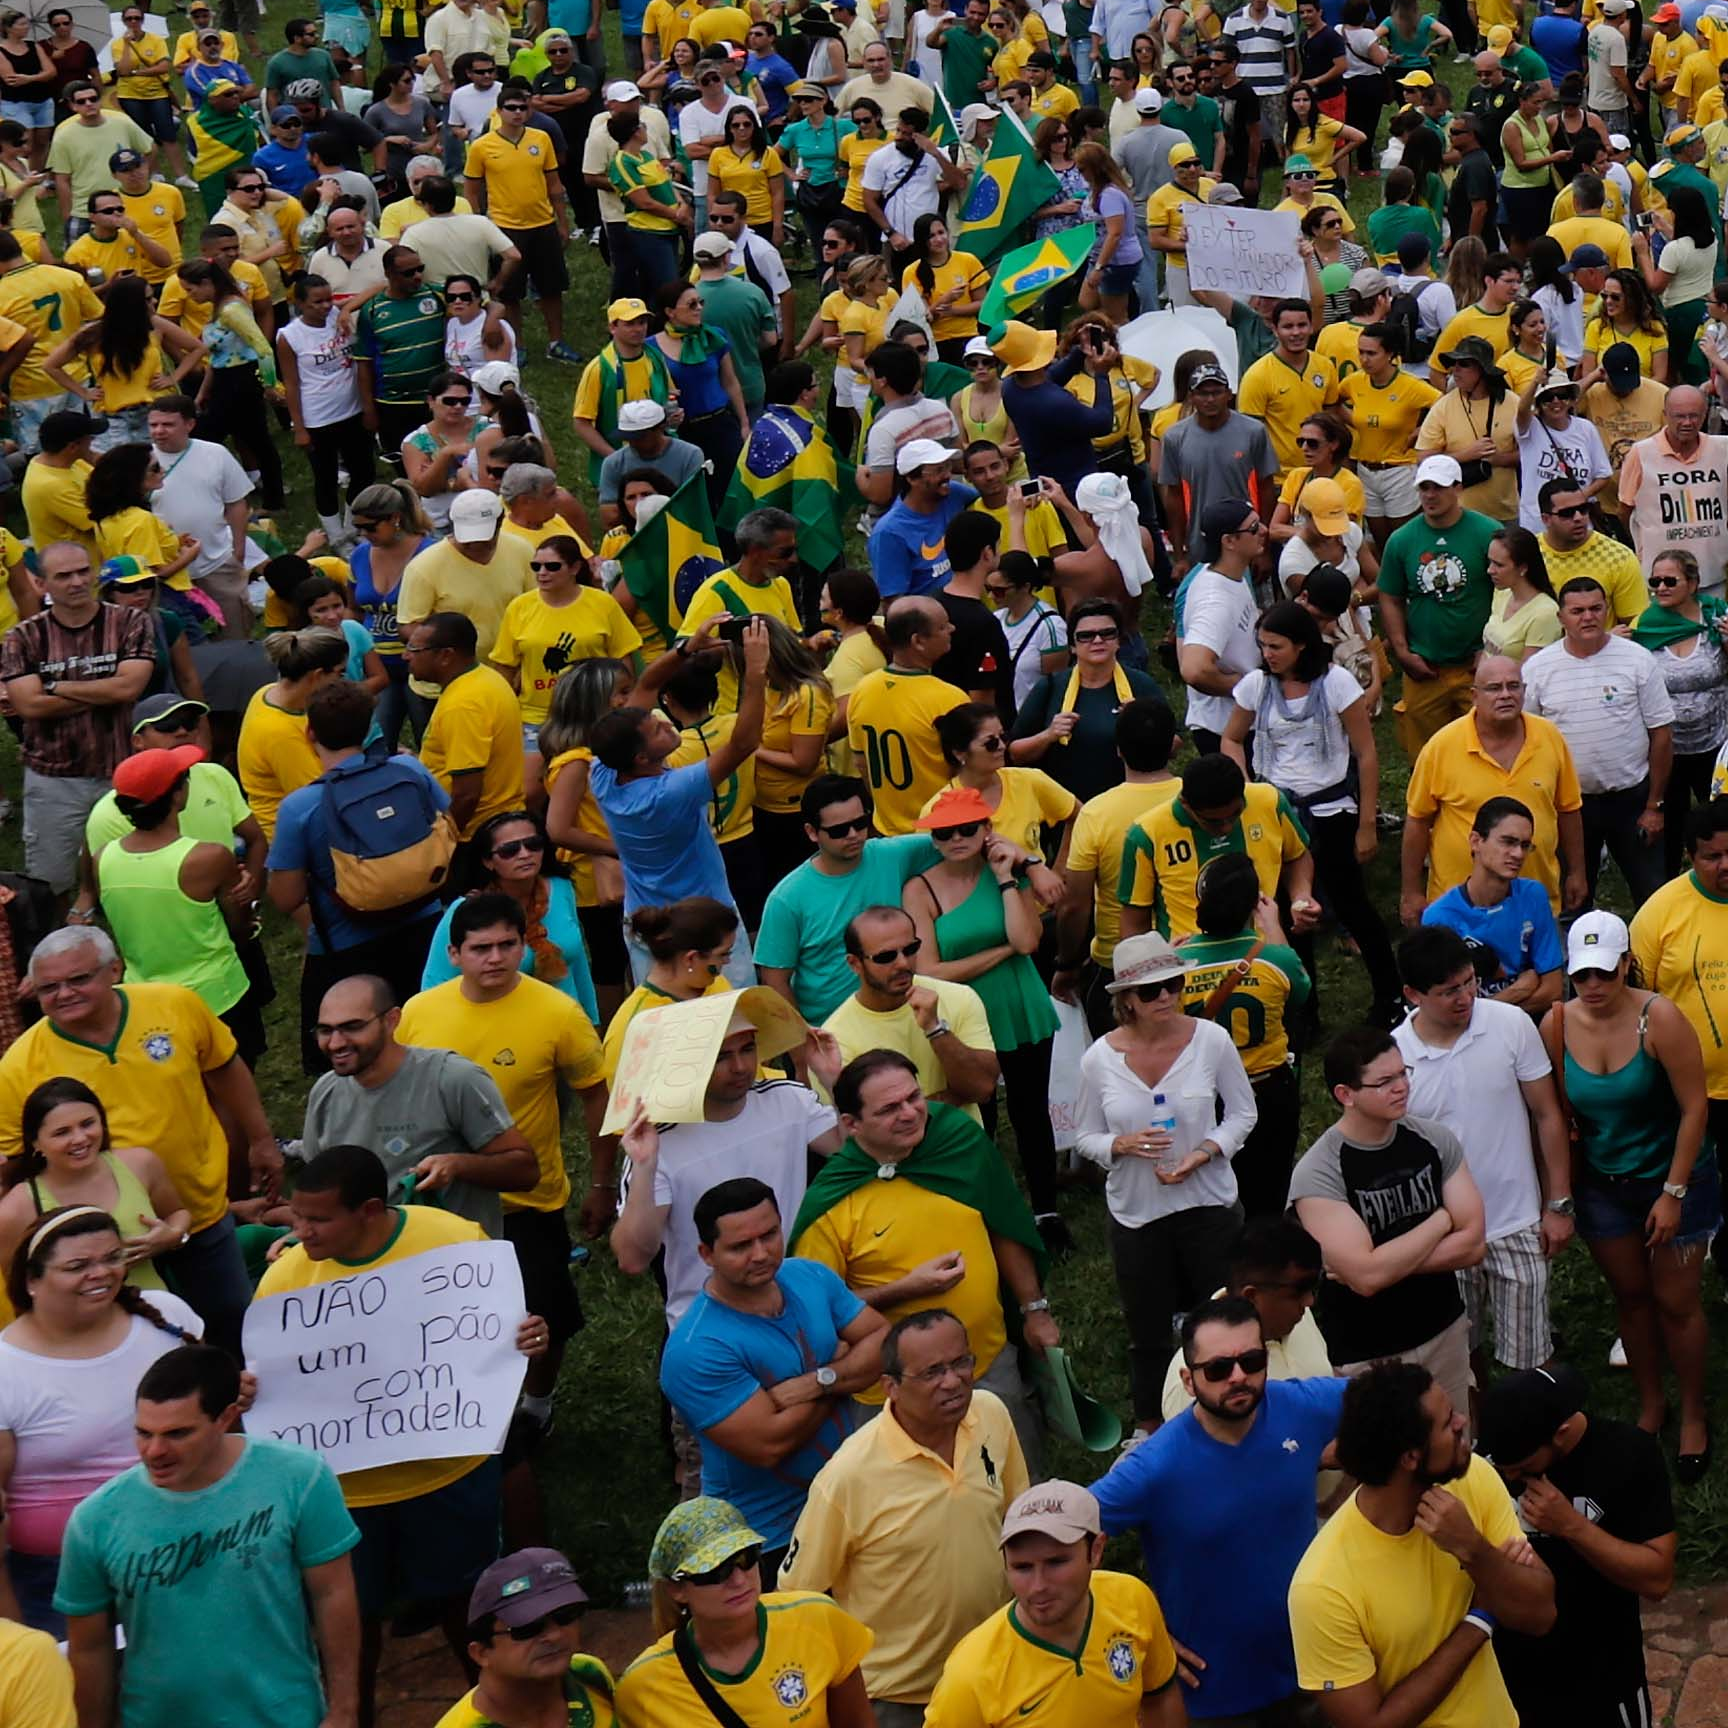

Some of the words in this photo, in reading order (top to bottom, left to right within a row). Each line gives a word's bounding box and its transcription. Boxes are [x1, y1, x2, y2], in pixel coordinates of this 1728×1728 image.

[31, 292, 62, 332] 7
[1657, 469, 1721, 486] FORA
[1665, 527, 1712, 540] IMPEACHMENT
[861, 724, 913, 791] 10
[1164, 839, 1193, 866] 10
[1701, 959, 1724, 970] Feliz
[1354, 1164, 1439, 1236] EVERLAST
[281, 1275, 388, 1333] NÃO
[298, 1341, 366, 1375] um
[419, 1304, 503, 1362] pão
[353, 1361, 455, 1405] com
[271, 1388, 487, 1451] mortadela
